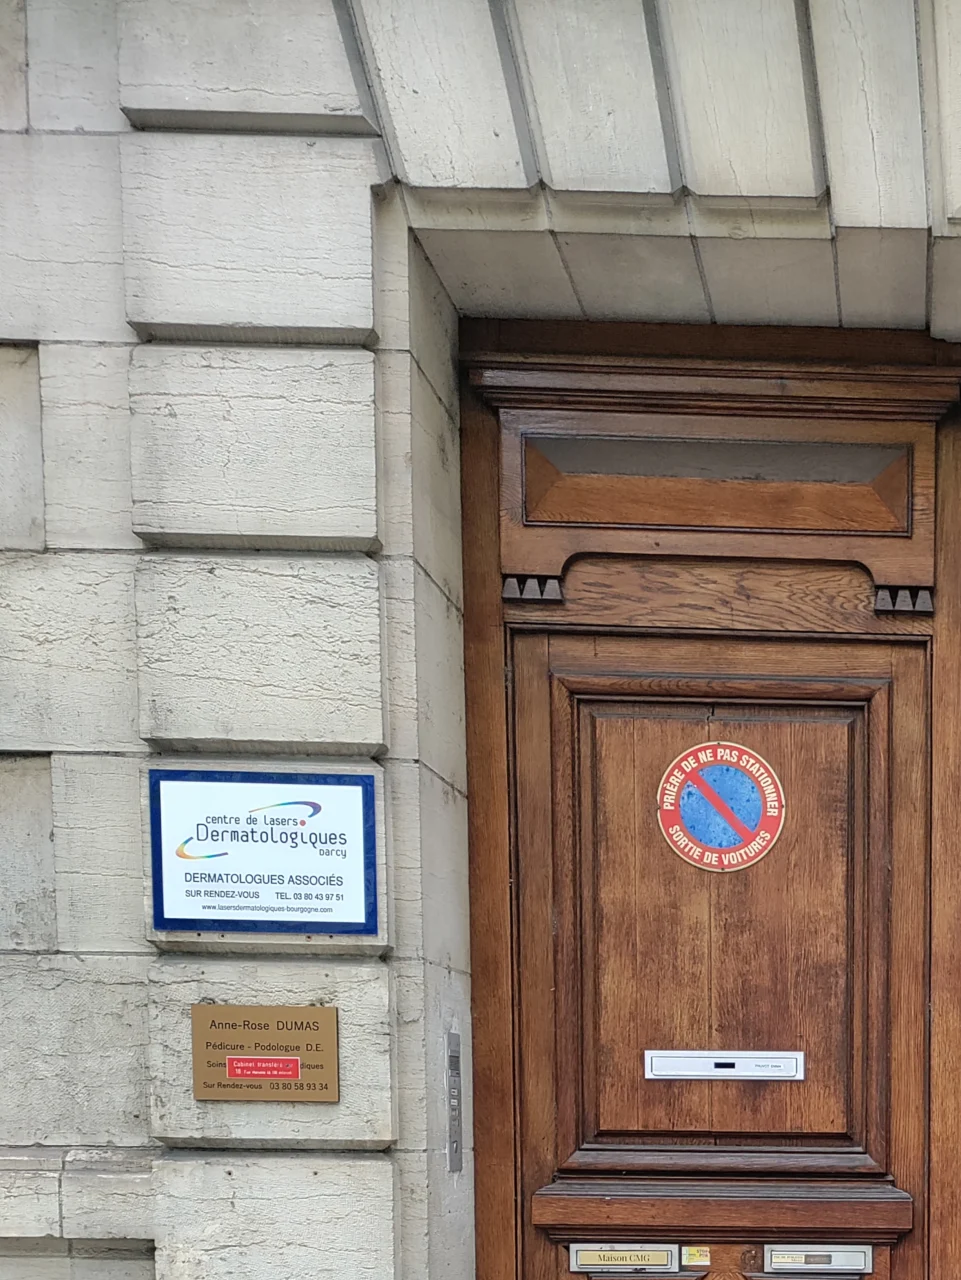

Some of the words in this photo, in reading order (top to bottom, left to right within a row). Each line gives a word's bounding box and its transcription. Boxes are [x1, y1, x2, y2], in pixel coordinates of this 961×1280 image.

[663, 768, 685, 810] PRIÈRE
[681, 756, 698, 773] DE
[697, 749, 715, 763] NE
[717, 748, 739, 763] PAS
[739, 754, 779, 817] STATIONNER
[205, 814, 241, 826] centre
[246, 814, 258, 826] de
[263, 815, 298, 827] lasers
[196, 823, 348, 850] Dermatologiques
[668, 825, 703, 860] SORTIE
[703, 851, 719, 865] DE
[721, 830, 771, 865] VOITURES
[184, 872, 285, 886] DERMATOLOGUES
[287, 873, 344, 887] ASSOCIÉS
[185, 889, 203, 899] SUR
[203, 889, 260, 899] RENDEZ-VOUS
[275, 891, 292, 901] TEL.
[293, 892, 303, 901] 03
[304, 892, 314, 901] 80
[314, 893, 324, 901] 43
[324, 893, 334, 901] 97
[336, 893, 344, 902] 51
[201, 903, 334, 914] www.lasersdermatologiques-bourgogne.com
[209, 1019, 270, 1031] Anne-Rose
[276, 1020, 320, 1032] DUMAS
[205, 1041, 245, 1051] Pédicure
[254, 1042, 301, 1053] Podologue
[305, 1043, 324, 1052] D.E.
[206, 1060, 227, 1069] Soins
[300, 1062, 324, 1071] diques
[202, 1081, 216, 1090] Sur
[216, 1081, 263, 1090] Rendez-vous
[269, 1082, 279, 1091] 03
[281, 1082, 292, 1091] 80
[294, 1082, 304, 1091] 58
[306, 1082, 317, 1091] 93
[318, 1083, 329, 1091] 34
[597, 1252, 626, 1263] Maison
[629, 1252, 651, 1263] CMG
